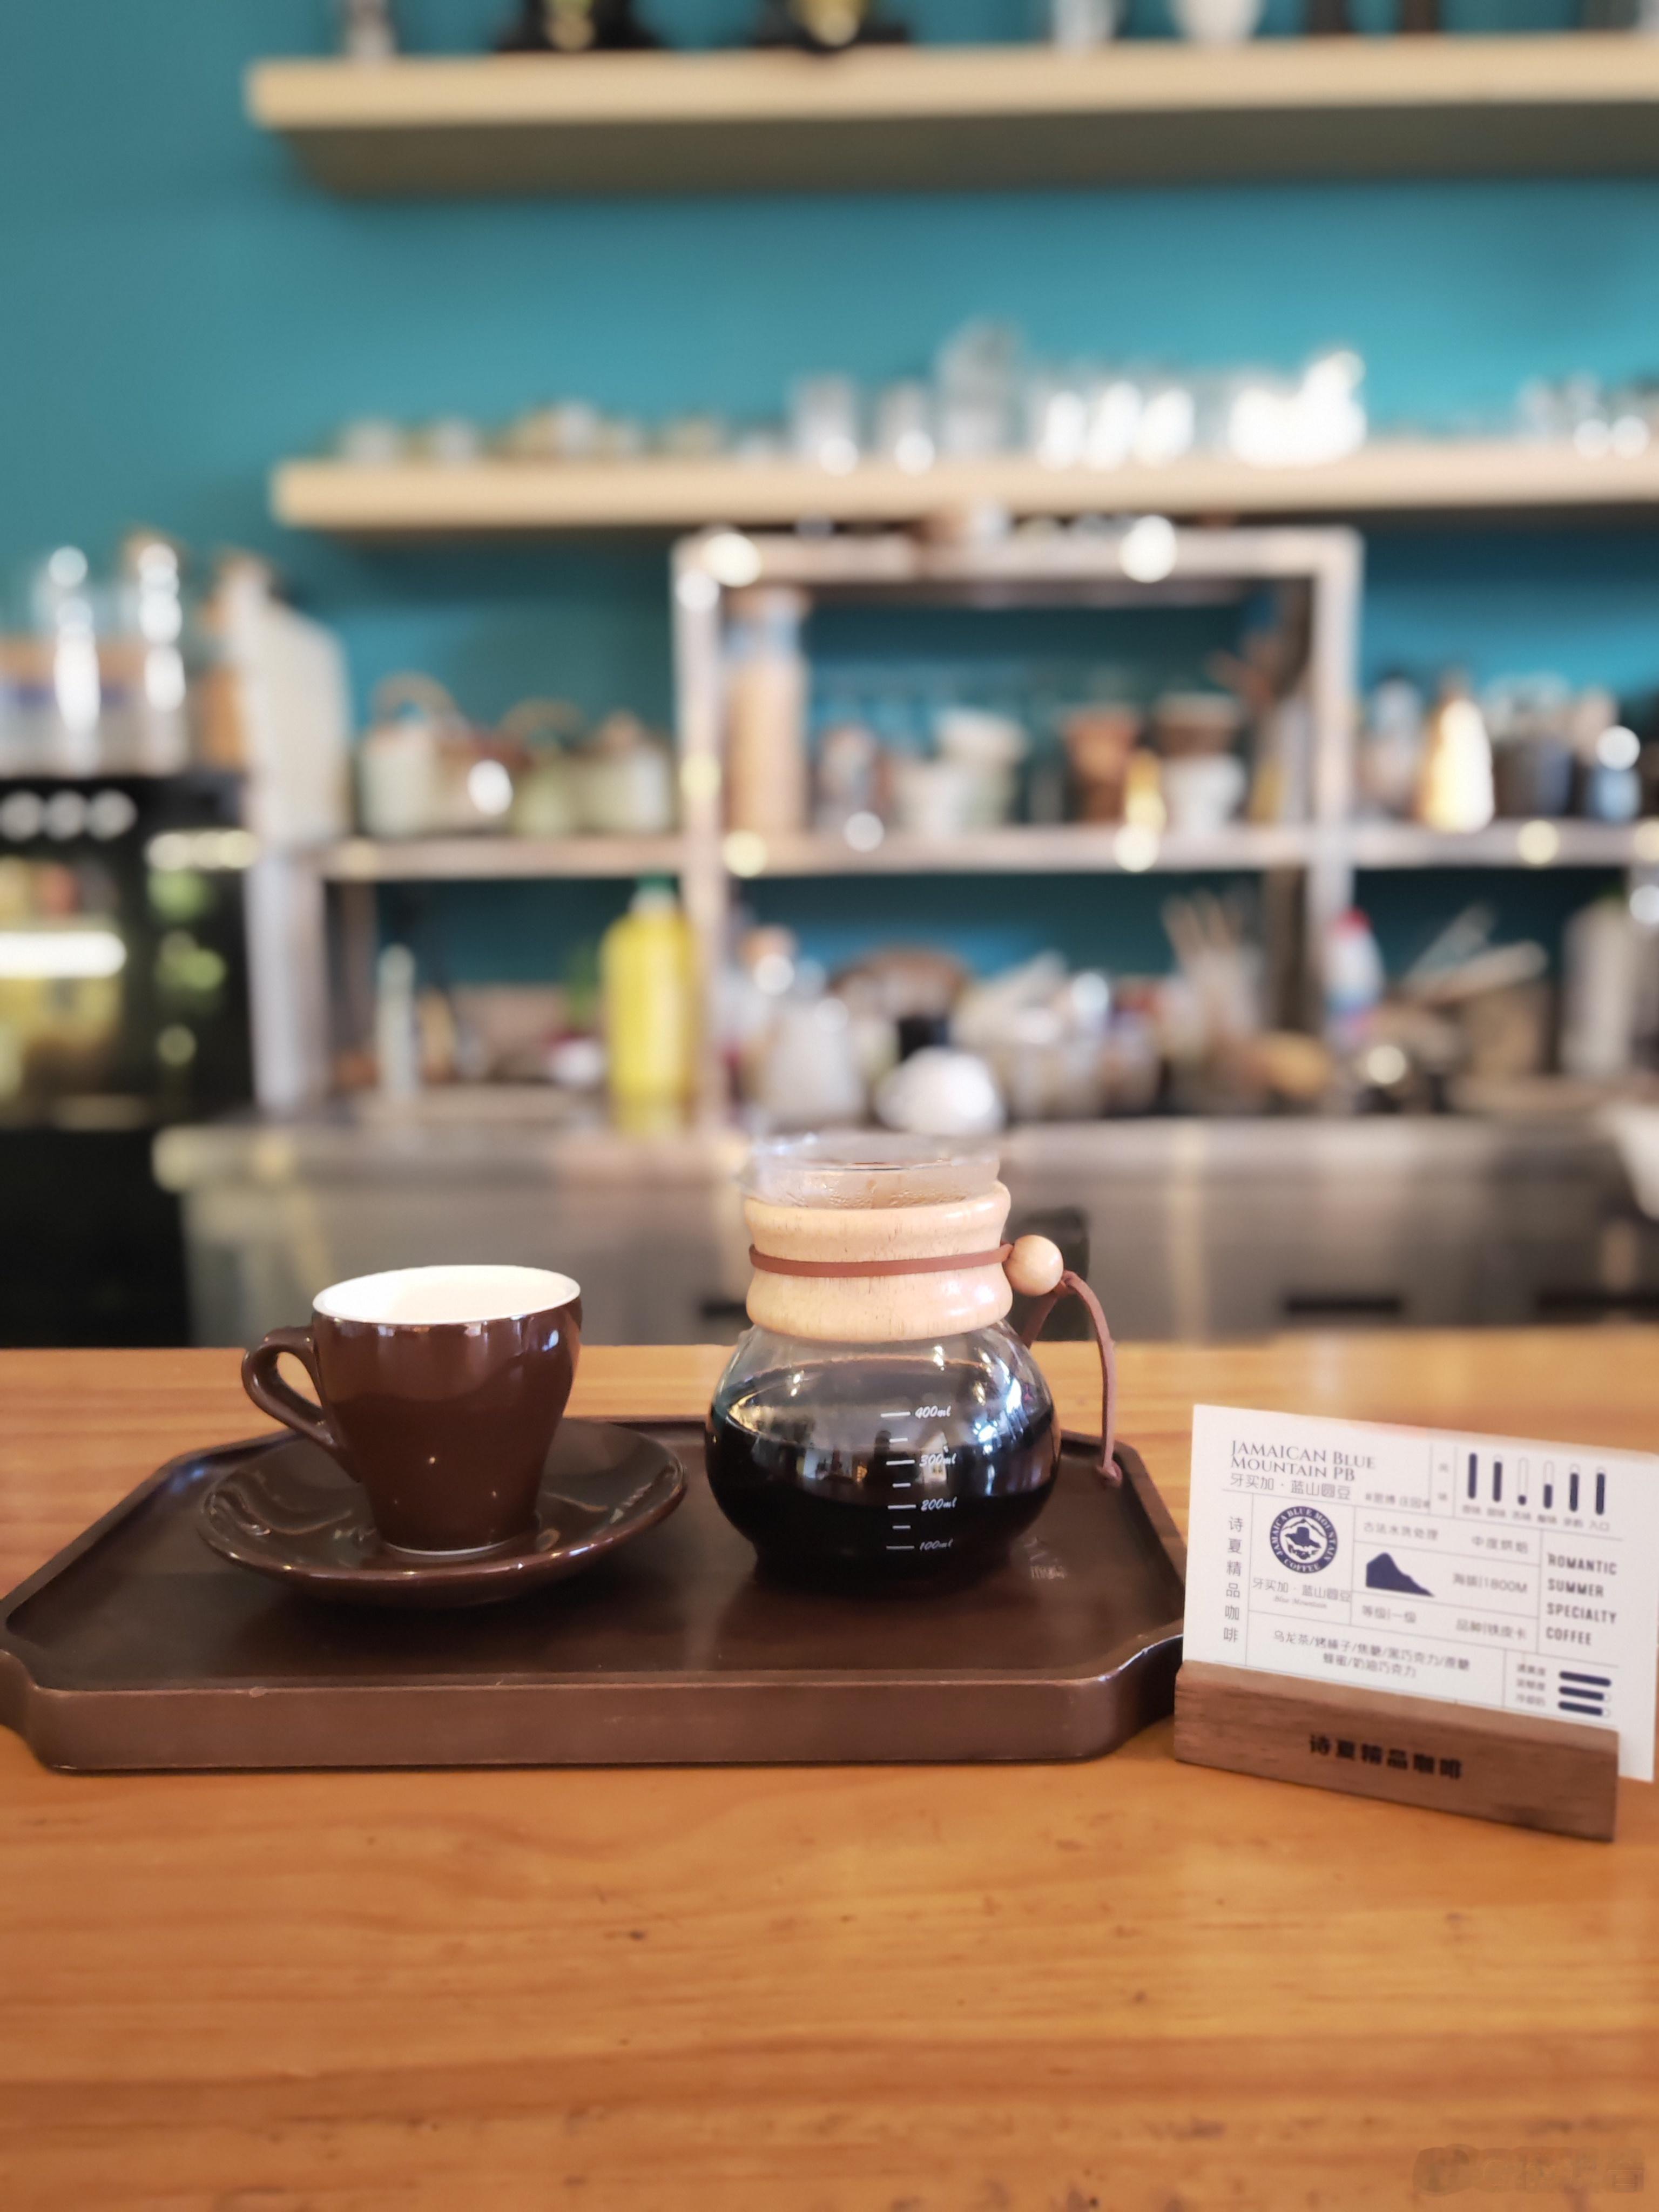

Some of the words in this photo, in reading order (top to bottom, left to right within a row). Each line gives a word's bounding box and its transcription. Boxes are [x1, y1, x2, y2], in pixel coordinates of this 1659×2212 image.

[915, 1405, 951, 1419] 400ml
[919, 1453, 957, 1467] 300ml
[1231, 1440, 1327, 1462] JAMAICAN
[1332, 1451, 1376, 1469] BLUE
[1231, 1458, 1327, 1478] MOUNTAIN
[1333, 1467, 1356, 1481] PB
[921, 1497, 957, 1512] 200ml
[919, 1539, 953, 1551] 100ml
[1548, 1553, 1617, 1575] ROMANTIC
[1223, 1516, 1244, 1643] 诗夏精品咖啡
[1548, 1578, 1604, 1597] SUMMER
[1547, 1602, 1617, 1624] SPECIALTY
[1546, 1627, 1591, 1645] COFFEE
